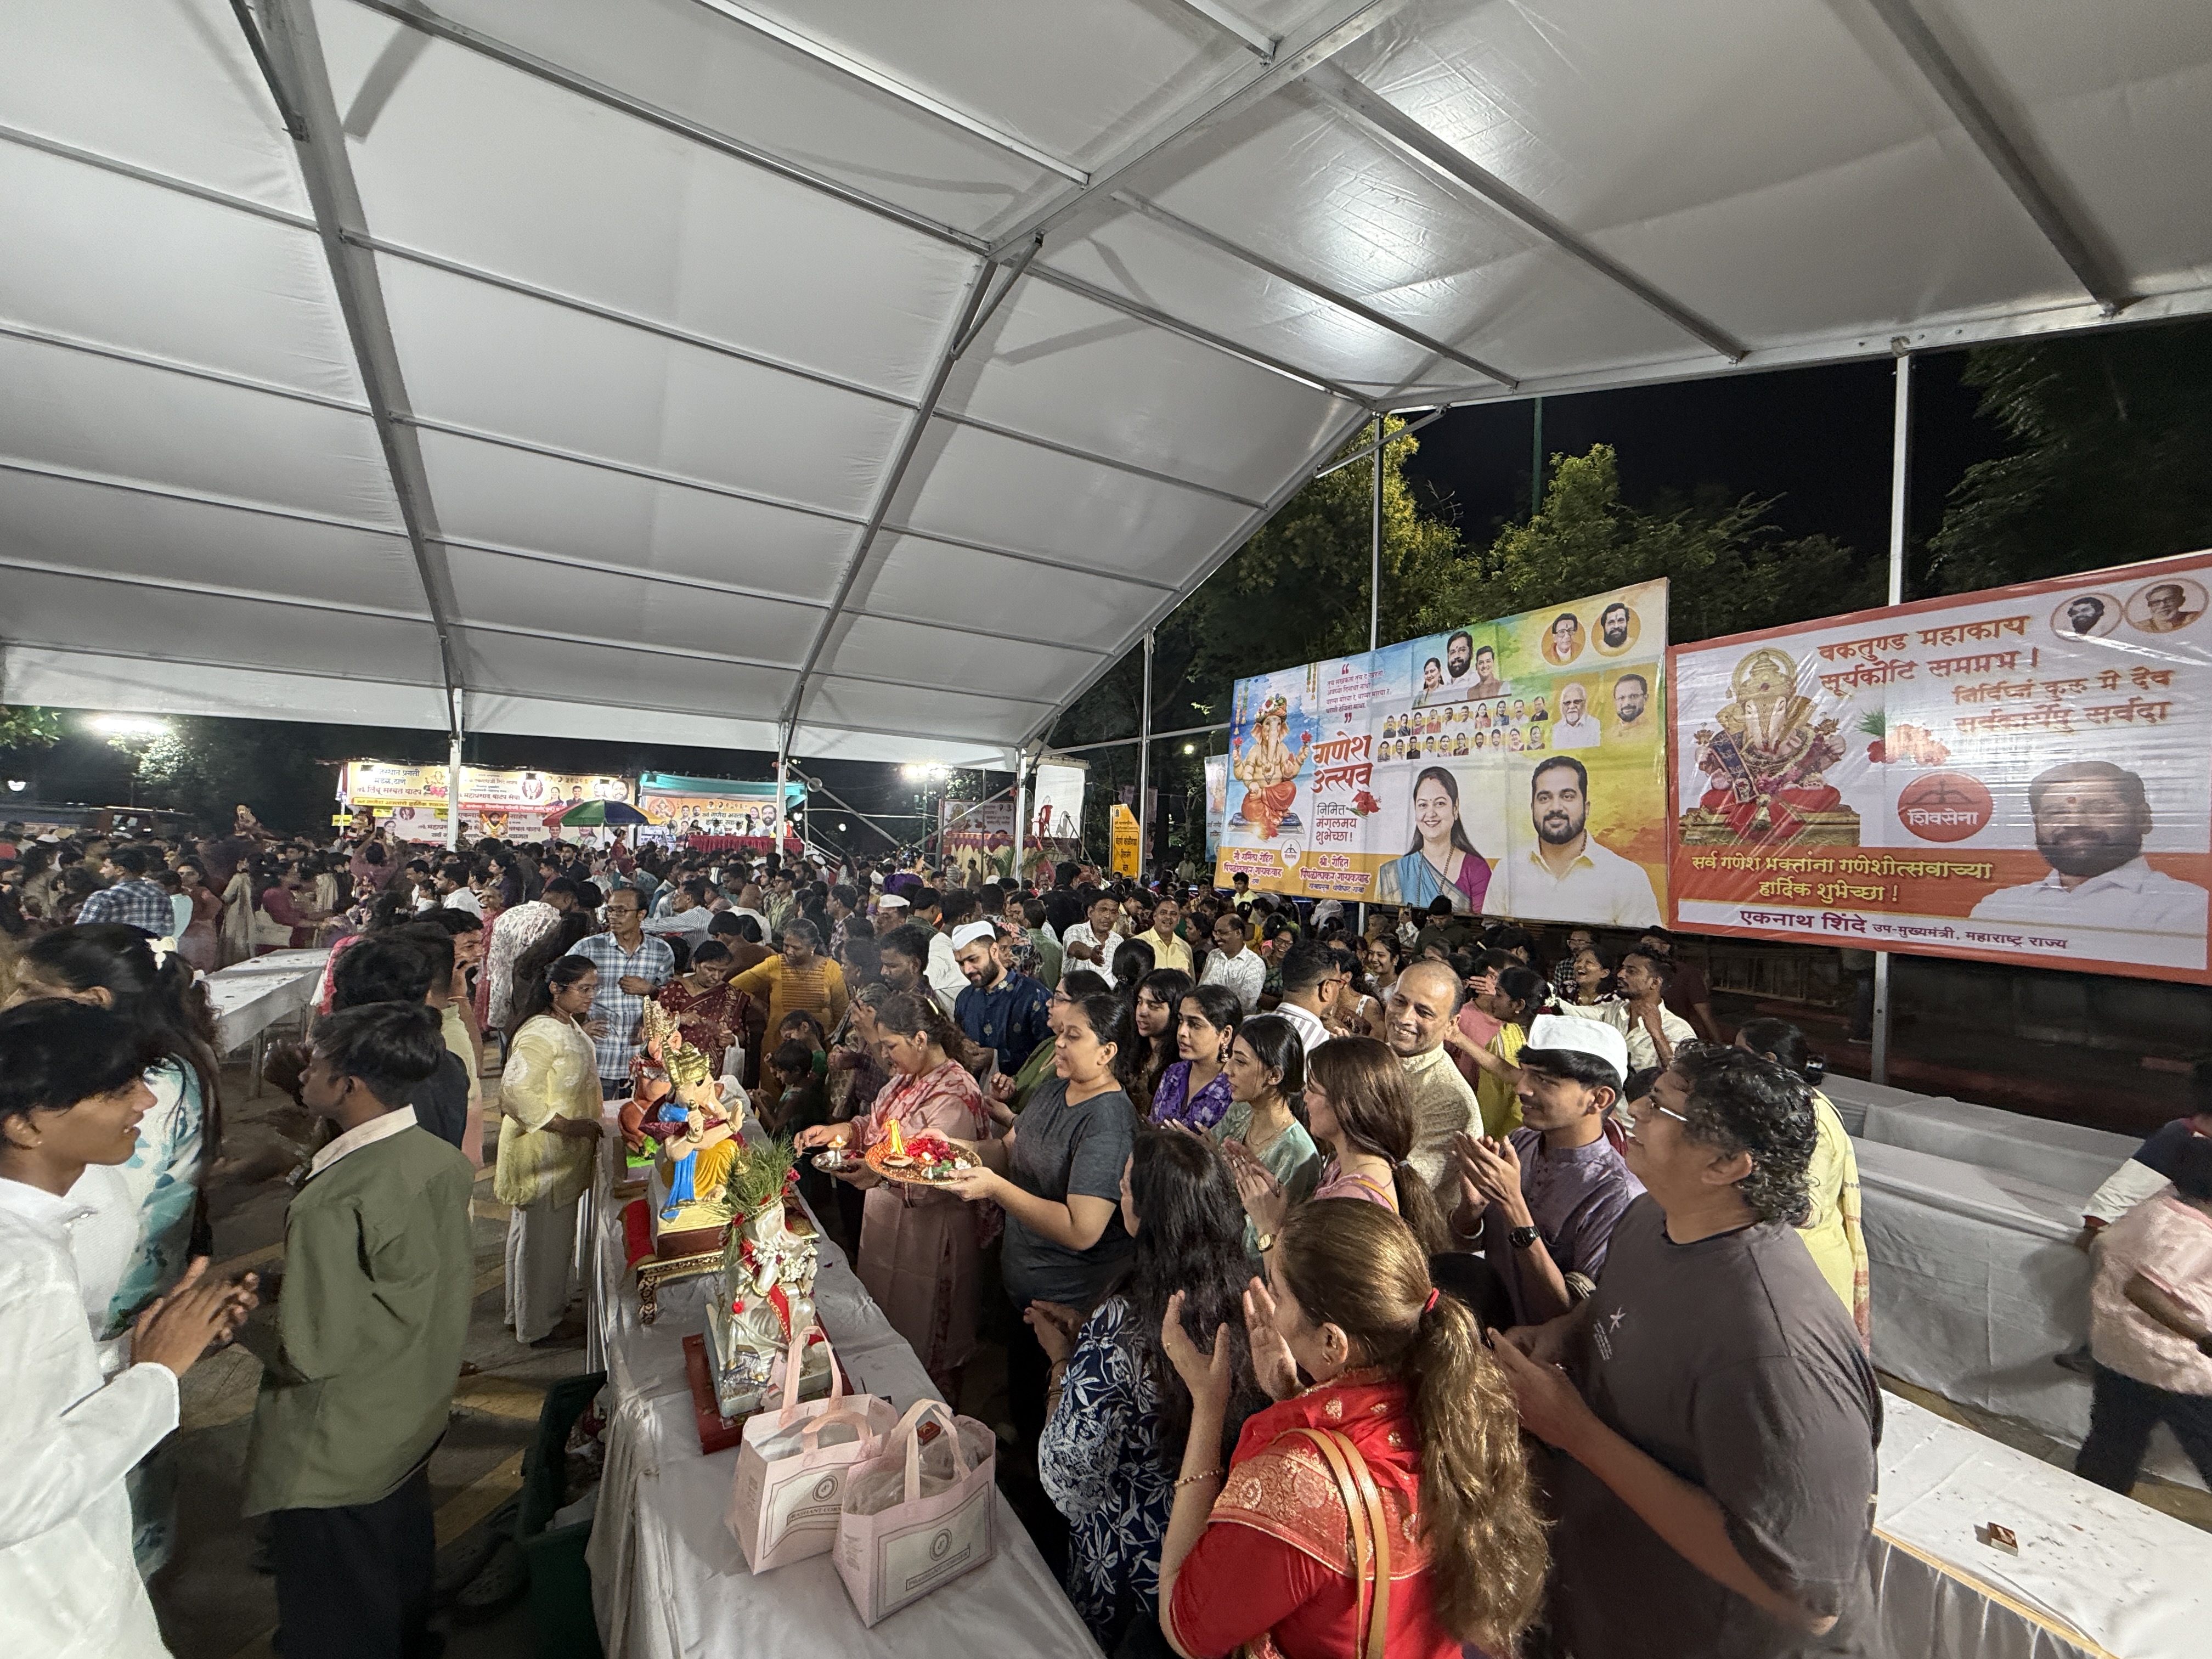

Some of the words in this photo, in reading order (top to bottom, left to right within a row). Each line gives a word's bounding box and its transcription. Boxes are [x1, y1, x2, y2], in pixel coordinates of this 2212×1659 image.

[1916, 616, 2030, 646] महाकाय
[1819, 659, 1919, 697] सूर्यकोटि
[2094, 670, 2122, 690] मे
[2129, 667, 2175, 690] देव
[2083, 696, 2174, 724] सर्वदा
[1312, 731, 1373, 766] गणेश
[1311, 762, 1374, 793] उत्सव
[1316, 815, 1357, 828] मंगलमय
[1317, 802, 1346, 816] निमित्त
[1906, 808, 1979, 826] शिवसेना
[1691, 850, 1718, 870] सर्व
[1720, 853, 1761, 871] गणेश
[1765, 850, 1835, 873] भक्तांना
[1839, 854, 1993, 879] गणेशोत्सवाच्या
[1759, 876, 1812, 899] हार्दिक
[1740, 911, 1814, 928] एकनाथ
[1821, 912, 1867, 933] शिंदे
[1872, 924, 1960, 941] उप-मुख्यमंत्री,
[1965, 931, 2023, 948] महाराष्ट्र
[2028, 937, 2068, 949] राज्य
